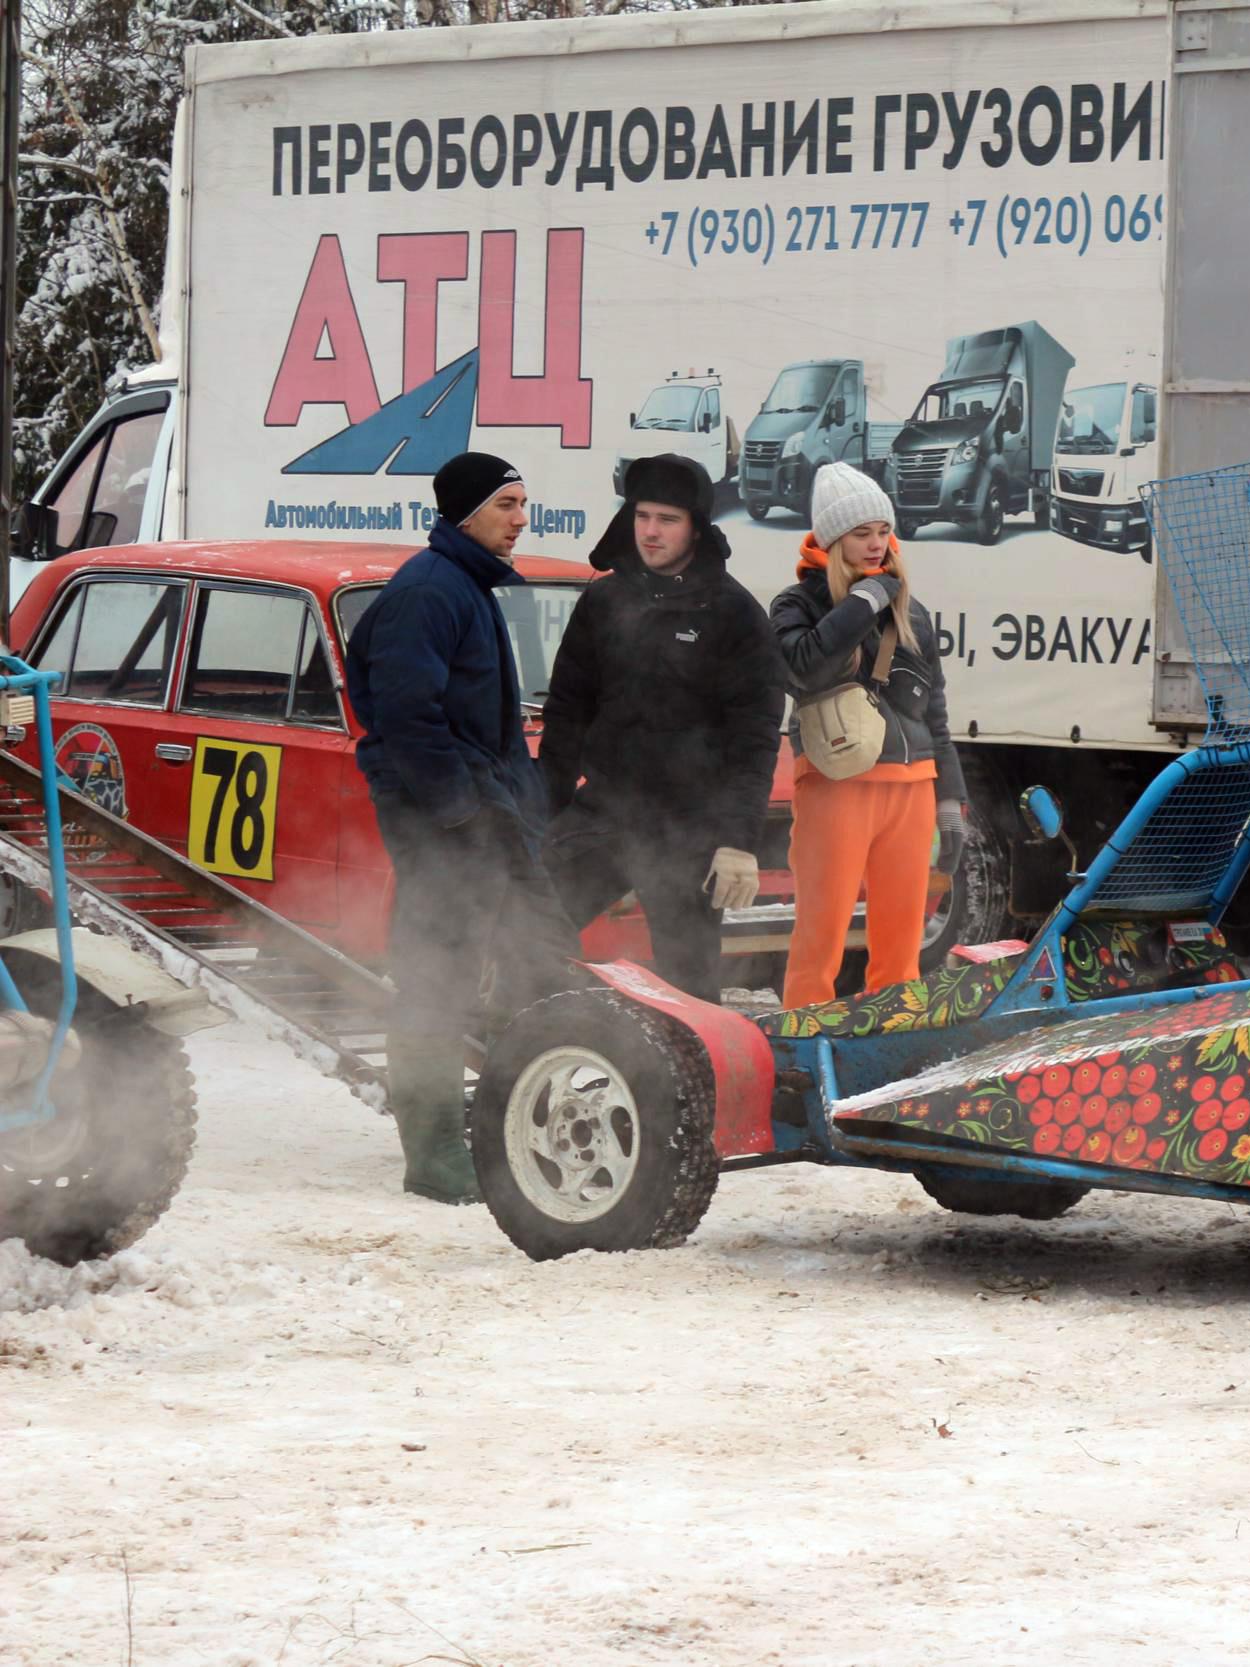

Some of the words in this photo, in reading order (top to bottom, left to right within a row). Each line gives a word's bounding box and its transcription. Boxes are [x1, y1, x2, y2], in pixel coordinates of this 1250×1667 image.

[272, 97, 854, 196] ПЕРЕОБОРУДОВАНИЕ
[873, 80, 1166, 172] ГРУЗОВИ
[645, 211, 679, 255] +7
[688, 203, 775, 267] (930)
[785, 205, 838, 251] 271
[850, 202, 930, 249] 7777
[949, 200, 986, 246] +7
[997, 192, 1092, 258] (920)
[263, 227, 593, 449] АТЦ
[264, 500, 402, 531] Автомобильный
[530, 504, 586, 539] Центр
[991, 613, 1151, 664] ЭВАКУА
[202, 747, 267, 870] 78
